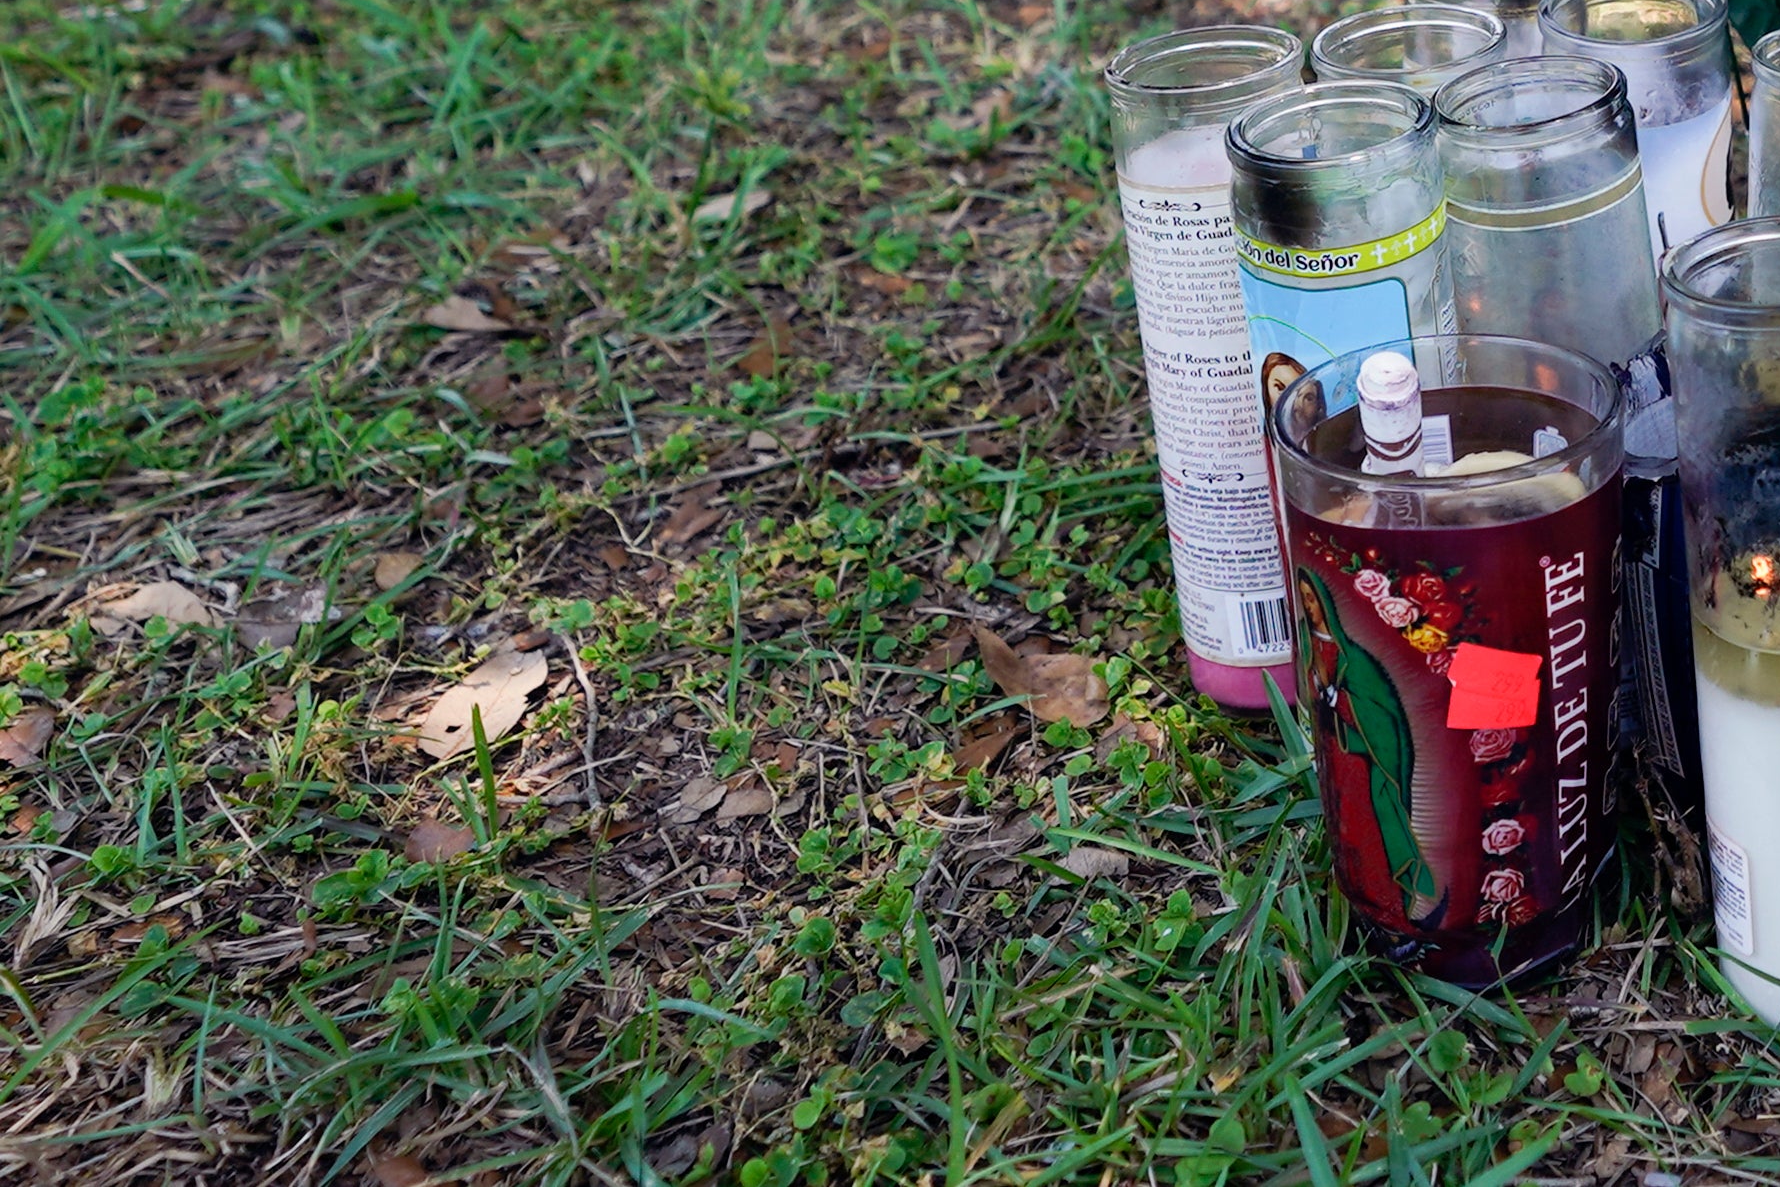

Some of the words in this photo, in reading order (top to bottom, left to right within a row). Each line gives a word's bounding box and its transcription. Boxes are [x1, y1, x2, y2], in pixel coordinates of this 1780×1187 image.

[1155, 215, 1168, 227] de
[1172, 215, 1210, 227] Rosas
[1214, 216, 1234, 228] pa
[1140, 224, 1173, 242] Virgen
[1177, 231, 1192, 241] de
[1196, 227, 1235, 241] Guad
[1202, 245, 1215, 255] de
[1265, 250, 1291, 269] del
[1296, 253, 1359, 272] Señor
[1174, 270, 1183, 279] te
[1186, 269, 1229, 279] amamos
[1230, 269, 1238, 279] y
[1156, 280, 1174, 291] Que
[1177, 281, 1186, 291] la
[1188, 280, 1216, 291] dulce
[1164, 293, 1193, 303] divino
[1195, 294, 1218, 305] Hijo
[1186, 305, 1226, 313] escuche
[1170, 353, 1181, 363] of
[1185, 353, 1221, 364] Roses
[1224, 353, 1238, 363] to
[1162, 363, 1186, 379] Mary
[1190, 368, 1202, 378] of
[1175, 381, 1198, 394] Mary
[1200, 384, 1211, 393] of
[1185, 395, 1242, 406] compassion
[1245, 393, 1257, 401] to
[1206, 407, 1229, 417] your
[1200, 419, 1225, 427] roses
[1228, 415, 1258, 425] reach
[1228, 428, 1249, 438] that
[1198, 441, 1214, 449] our
[1217, 440, 1242, 449] tears
[1548, 618, 1587, 690] TU
[1554, 686, 1588, 765] DE
[1558, 761, 1588, 866] LUZ
